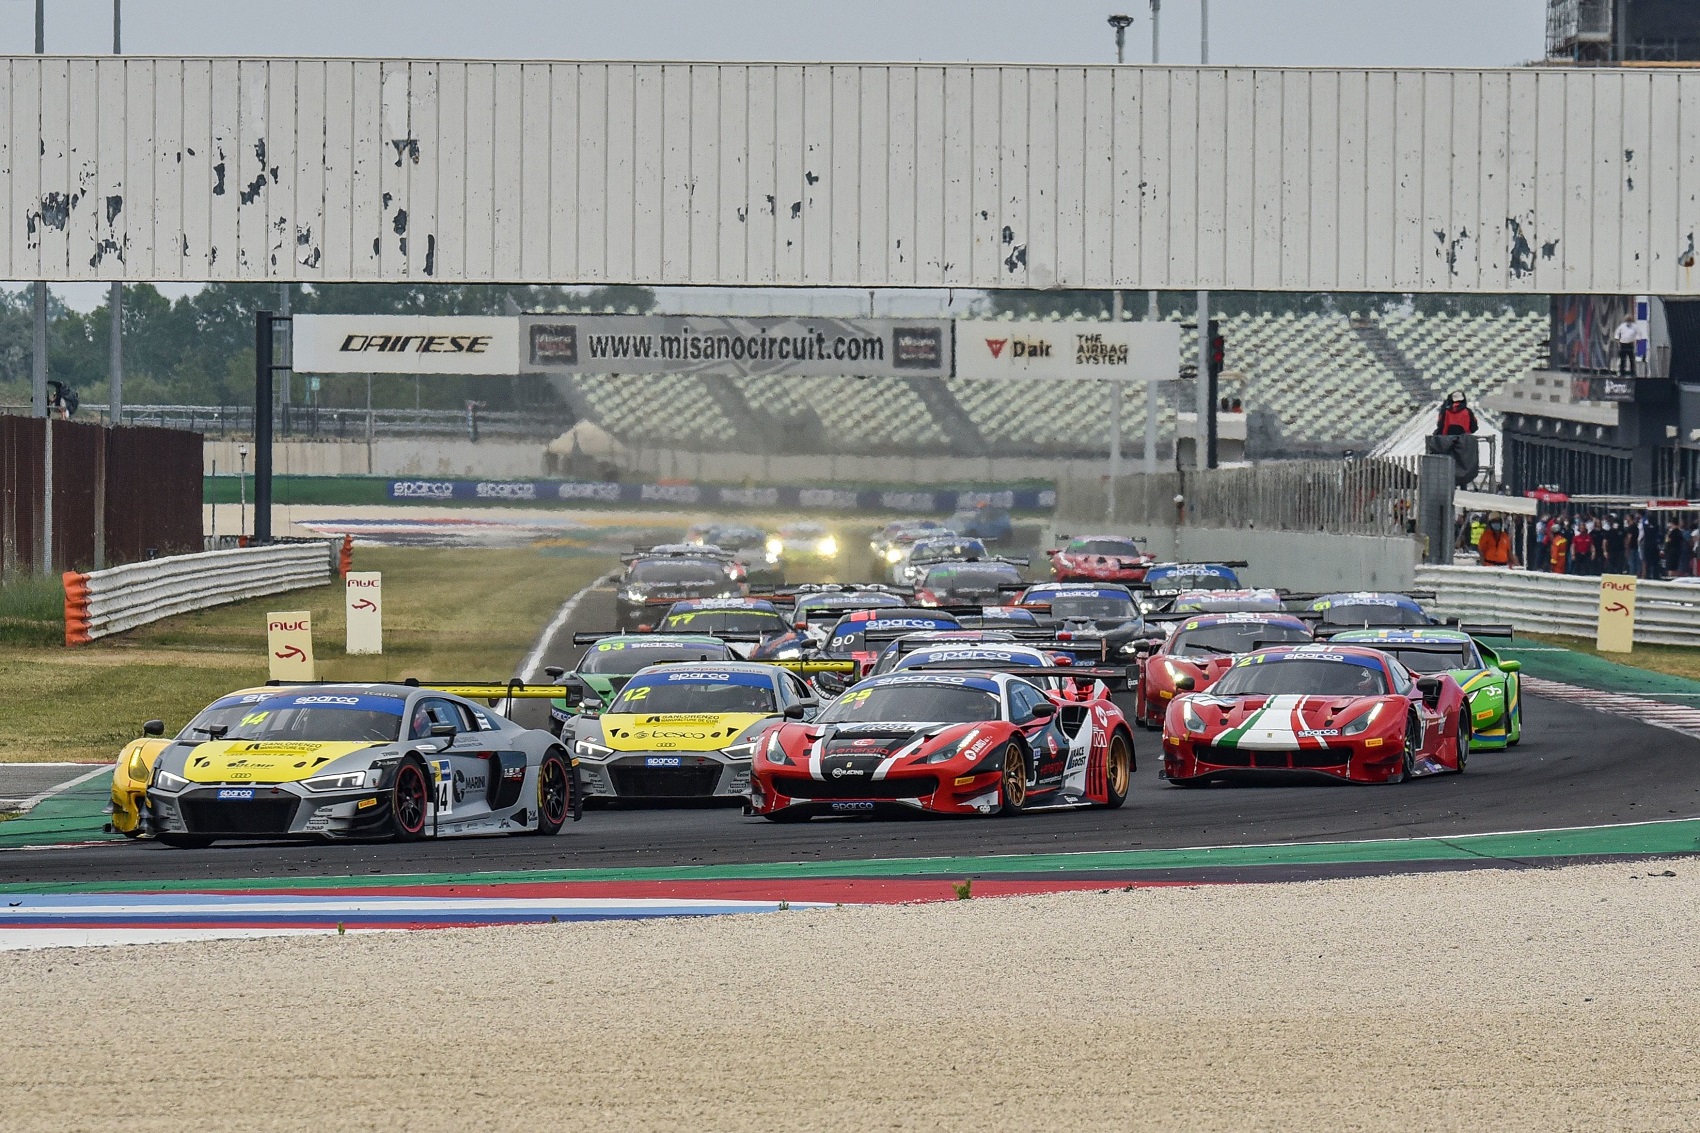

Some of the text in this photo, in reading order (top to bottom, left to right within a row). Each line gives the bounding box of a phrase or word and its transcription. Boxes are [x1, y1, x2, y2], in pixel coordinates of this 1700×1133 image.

[339, 334, 493, 353] DAINESE
[589, 326, 883, 361] www.misanocircuit.com
[1075, 355, 1127, 365] SYSTEM
[865, 619, 936, 630] sparco
[832, 634, 855, 647] 90
[928, 650, 1012, 662] sparco
[1236, 653, 1344, 668] 21 sparco
[668, 672, 730, 681] sparco
[874, 675, 967, 687] sparco
[293, 695, 359, 705] sparco
[622, 687, 651, 702] 12
[840, 688, 874, 705] 25
[240, 711, 270, 727] 14
[1297, 729, 1339, 737] sparco
[646, 757, 680, 766] sparco
[465, 776, 486, 790] MARINI
[219, 789, 252, 799] sparco
[436, 783, 448, 812] 14
[832, 802, 874, 811] sparco
